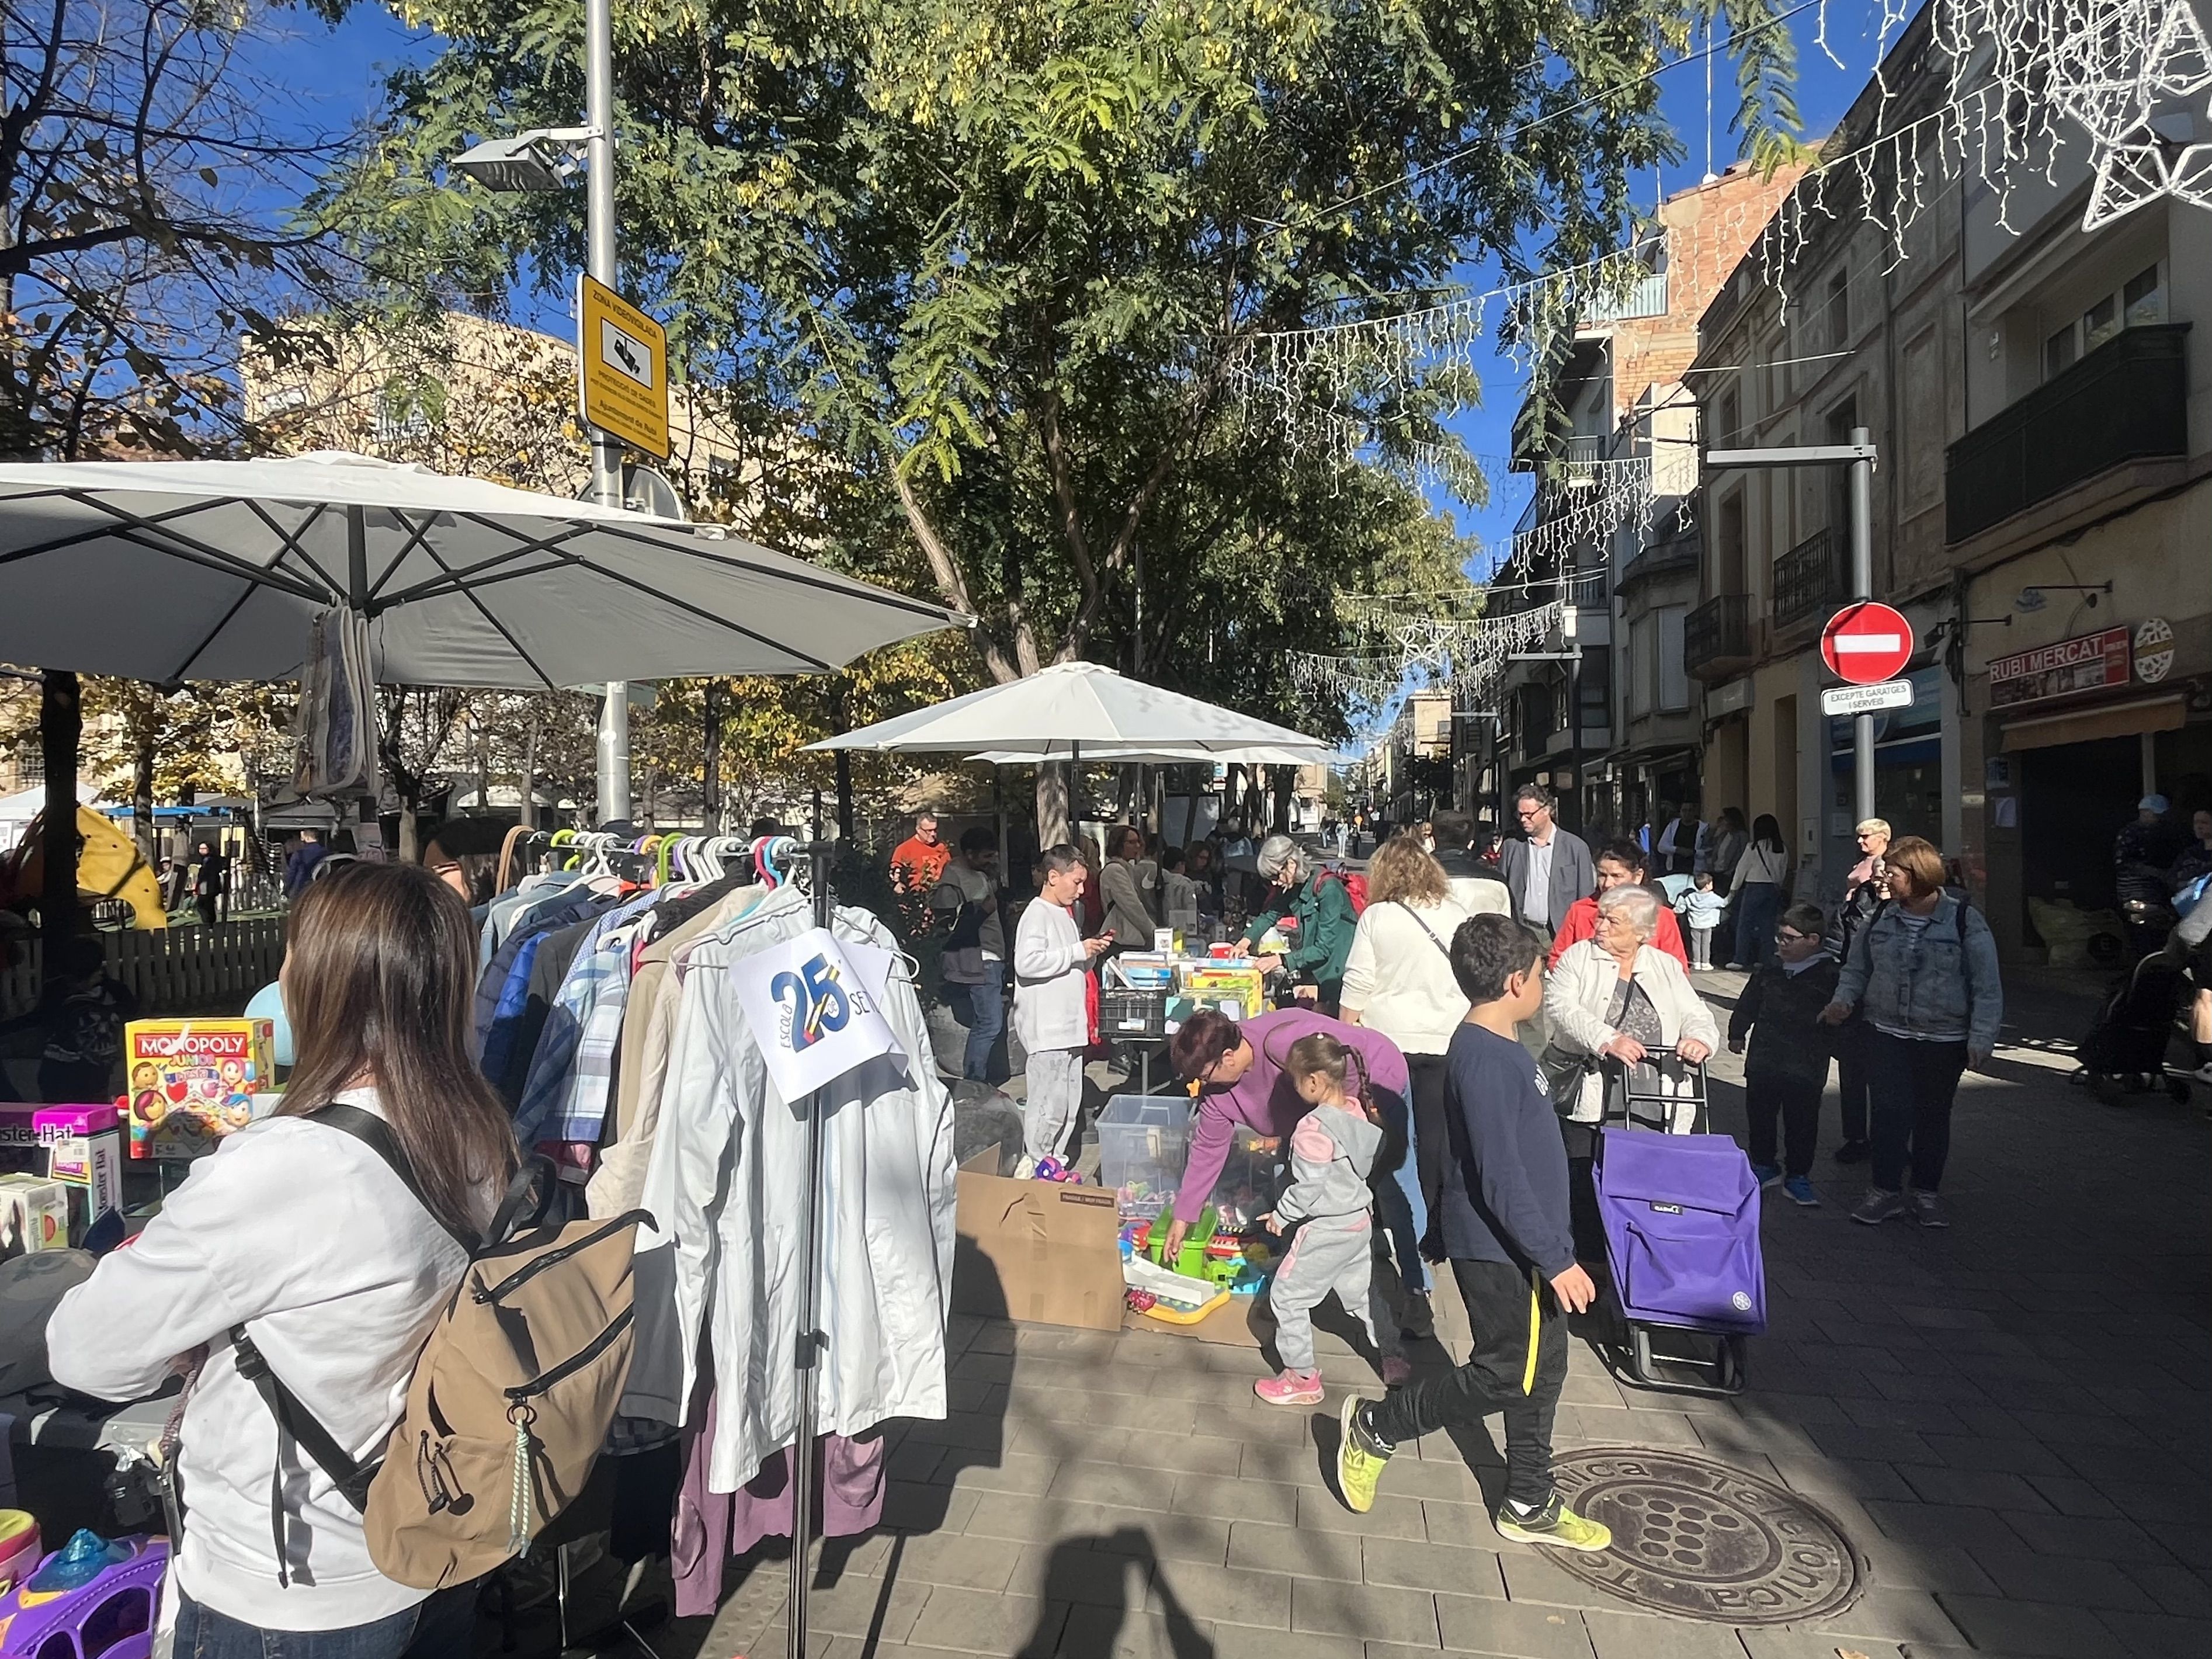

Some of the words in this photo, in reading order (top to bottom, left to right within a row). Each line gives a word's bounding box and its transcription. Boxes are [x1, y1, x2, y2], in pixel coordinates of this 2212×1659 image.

[593, 290, 611, 309] ZONA
[1989, 658, 2026, 682] RUBI
[2030, 637, 2102, 671] MERCAT
[1831, 690, 1864, 702] EXCEPTE
[1866, 685, 1907, 697] GARATGES
[1852, 697, 1884, 709] SERVEIS
[771, 953, 850, 1053] 25
[780, 1003, 793, 1049] ESCOLA
[169, 1053, 217, 1067] JUNIOR
[0, 1125, 34, 1141] ster
[43, 1125, 71, 1142] Hat
[95, 1148, 107, 1170] Hat
